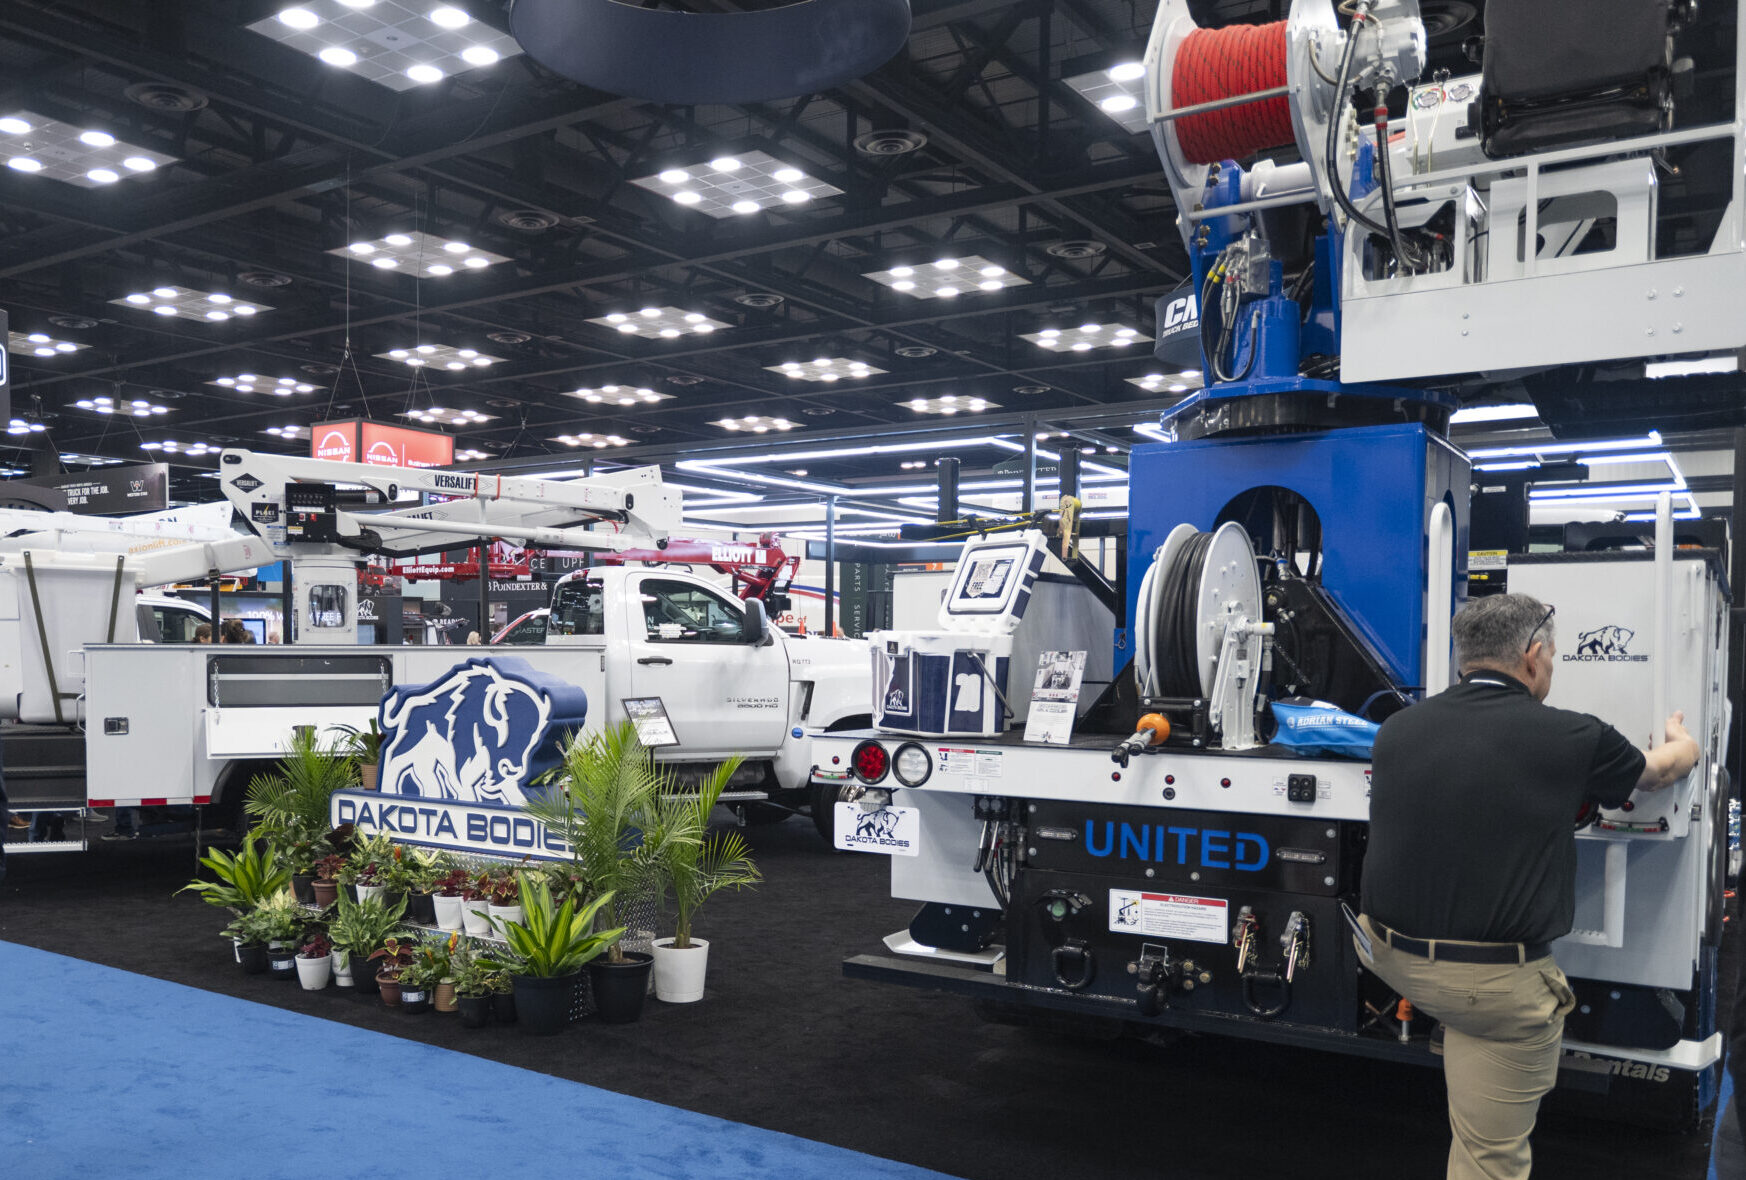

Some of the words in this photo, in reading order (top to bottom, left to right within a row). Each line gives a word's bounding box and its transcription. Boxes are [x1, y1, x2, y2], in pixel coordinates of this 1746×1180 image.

[317, 447, 351, 457] NISSAN
[367, 453, 398, 463] NISSAN
[434, 474, 477, 490] VERSALIFT
[67, 487, 81, 497] TRUCK
[82, 487, 90, 496] FOR
[90, 486, 99, 495] THE
[99, 485, 110, 494] JOB.
[79, 496, 89, 505] JOB.
[711, 545, 753, 563] ELLIOTT
[402, 565, 455, 575] ElliottEquip.com
[492, 581, 540, 592] POINDEXTER
[540, 582, 548, 590] &
[1562, 654, 1605, 662] DAKOTA
[1608, 654, 1648, 662] BODIES
[1296, 714, 1334, 727] ADRIAN
[1335, 714, 1368, 726] STEEL
[338, 799, 458, 840] DAKOTA
[845, 834, 878, 844] DAKOTA
[879, 837, 910, 848] BODIES
[1085, 818, 1270, 872] UNITED
[1174, 896, 1199, 905] DANGER
